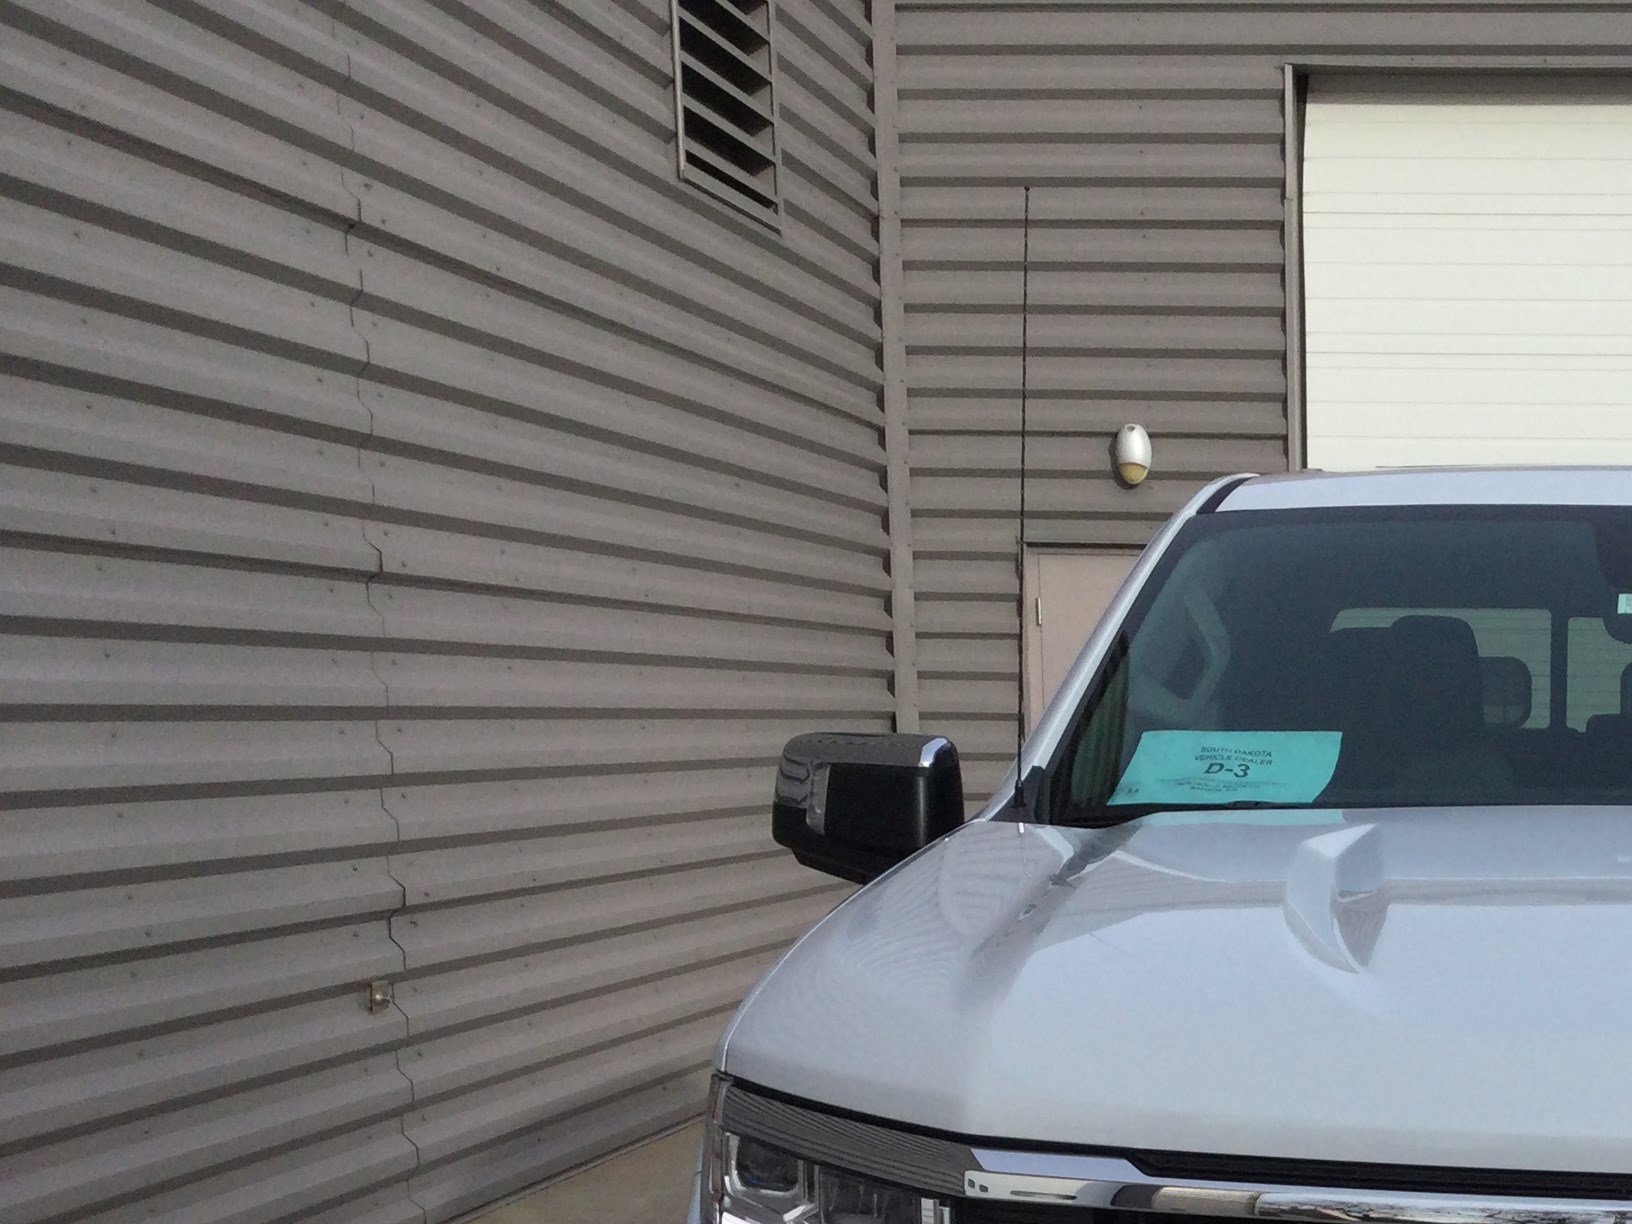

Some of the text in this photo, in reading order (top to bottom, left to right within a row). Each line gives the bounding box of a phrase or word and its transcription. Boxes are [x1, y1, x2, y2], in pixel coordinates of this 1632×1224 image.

[1234, 749, 1272, 757] DAKOTA
[1234, 755, 1273, 765] DEALER
[1203, 762, 1250, 778] D-3
